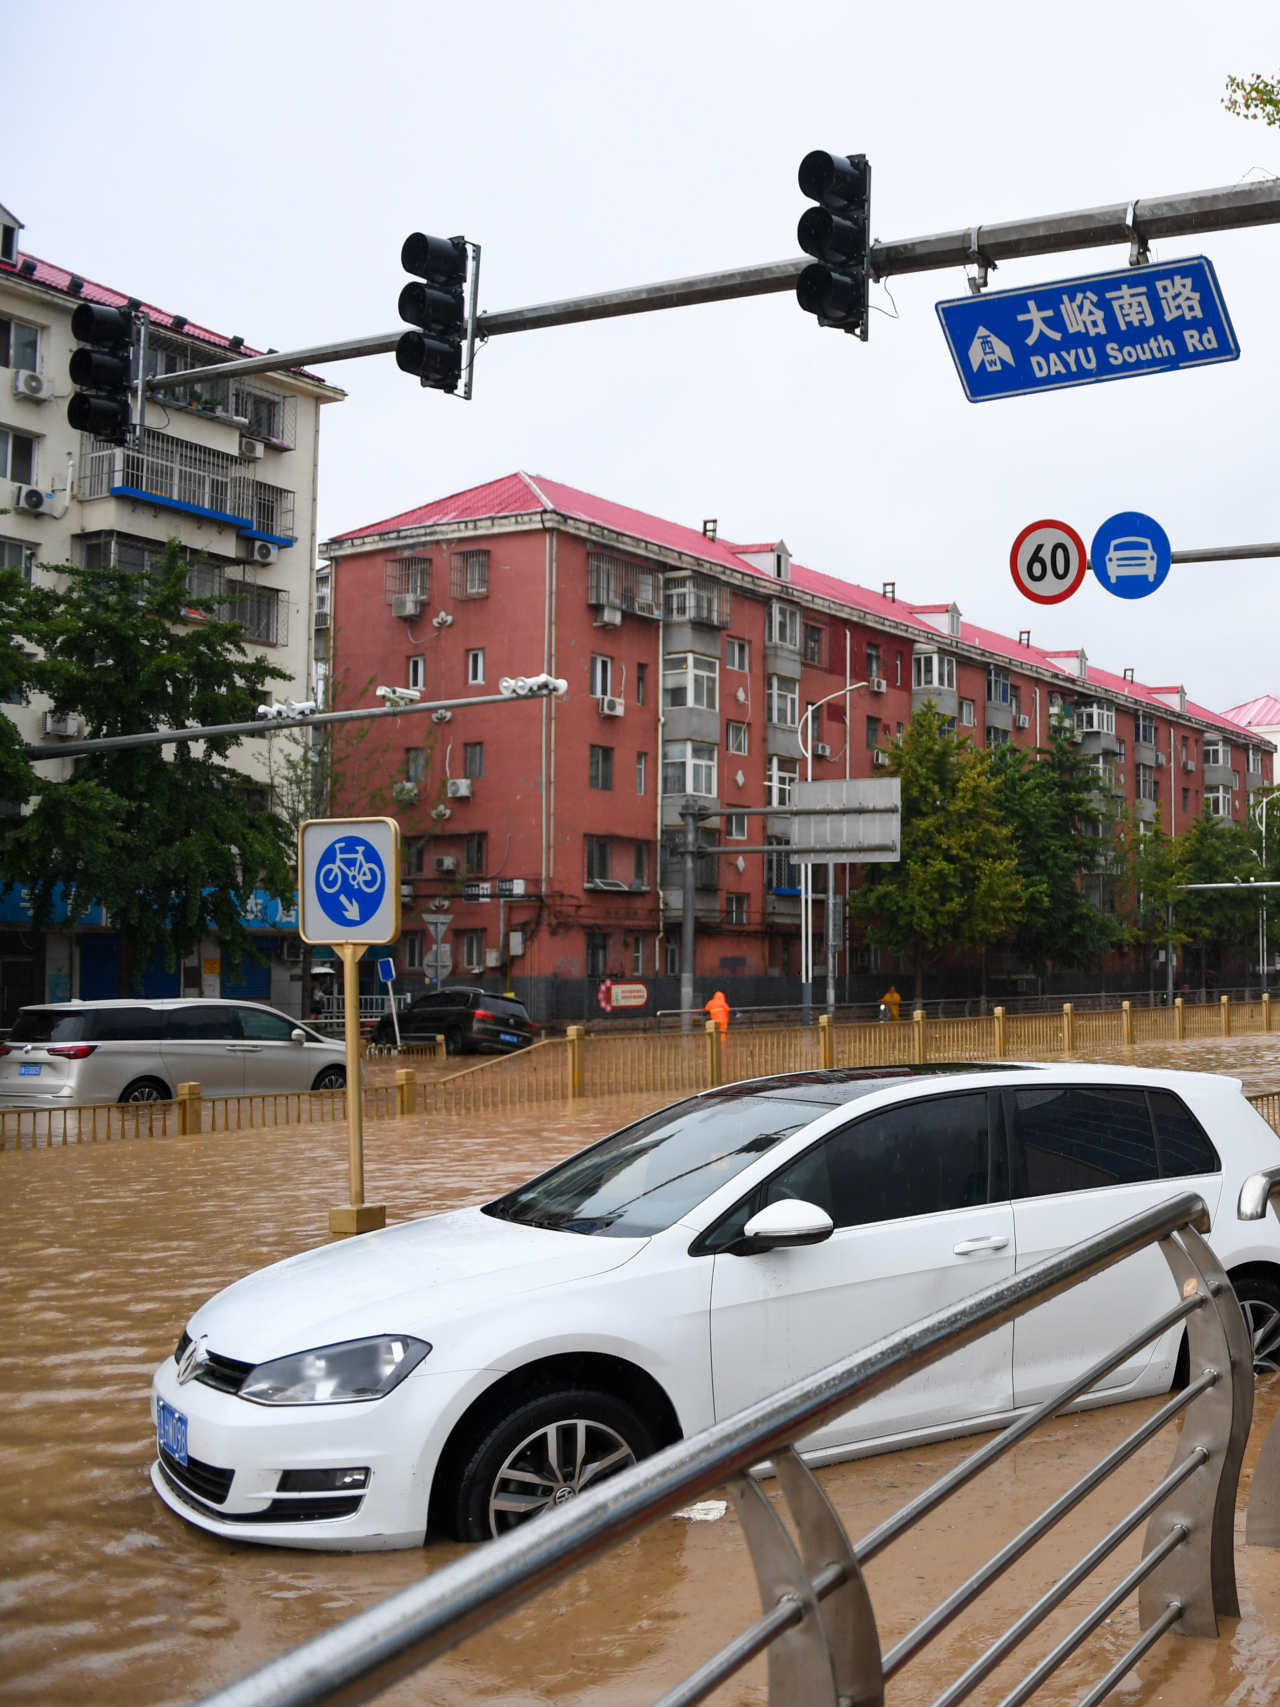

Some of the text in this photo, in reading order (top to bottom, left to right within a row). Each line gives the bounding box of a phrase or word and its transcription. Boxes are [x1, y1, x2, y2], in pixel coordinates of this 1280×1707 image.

[1017, 275, 1204, 346] 大峪南路
[976, 333, 997, 355] 西
[1030, 327, 1219, 378] DAYU South Rd
[1026, 542, 1071, 582] 60
